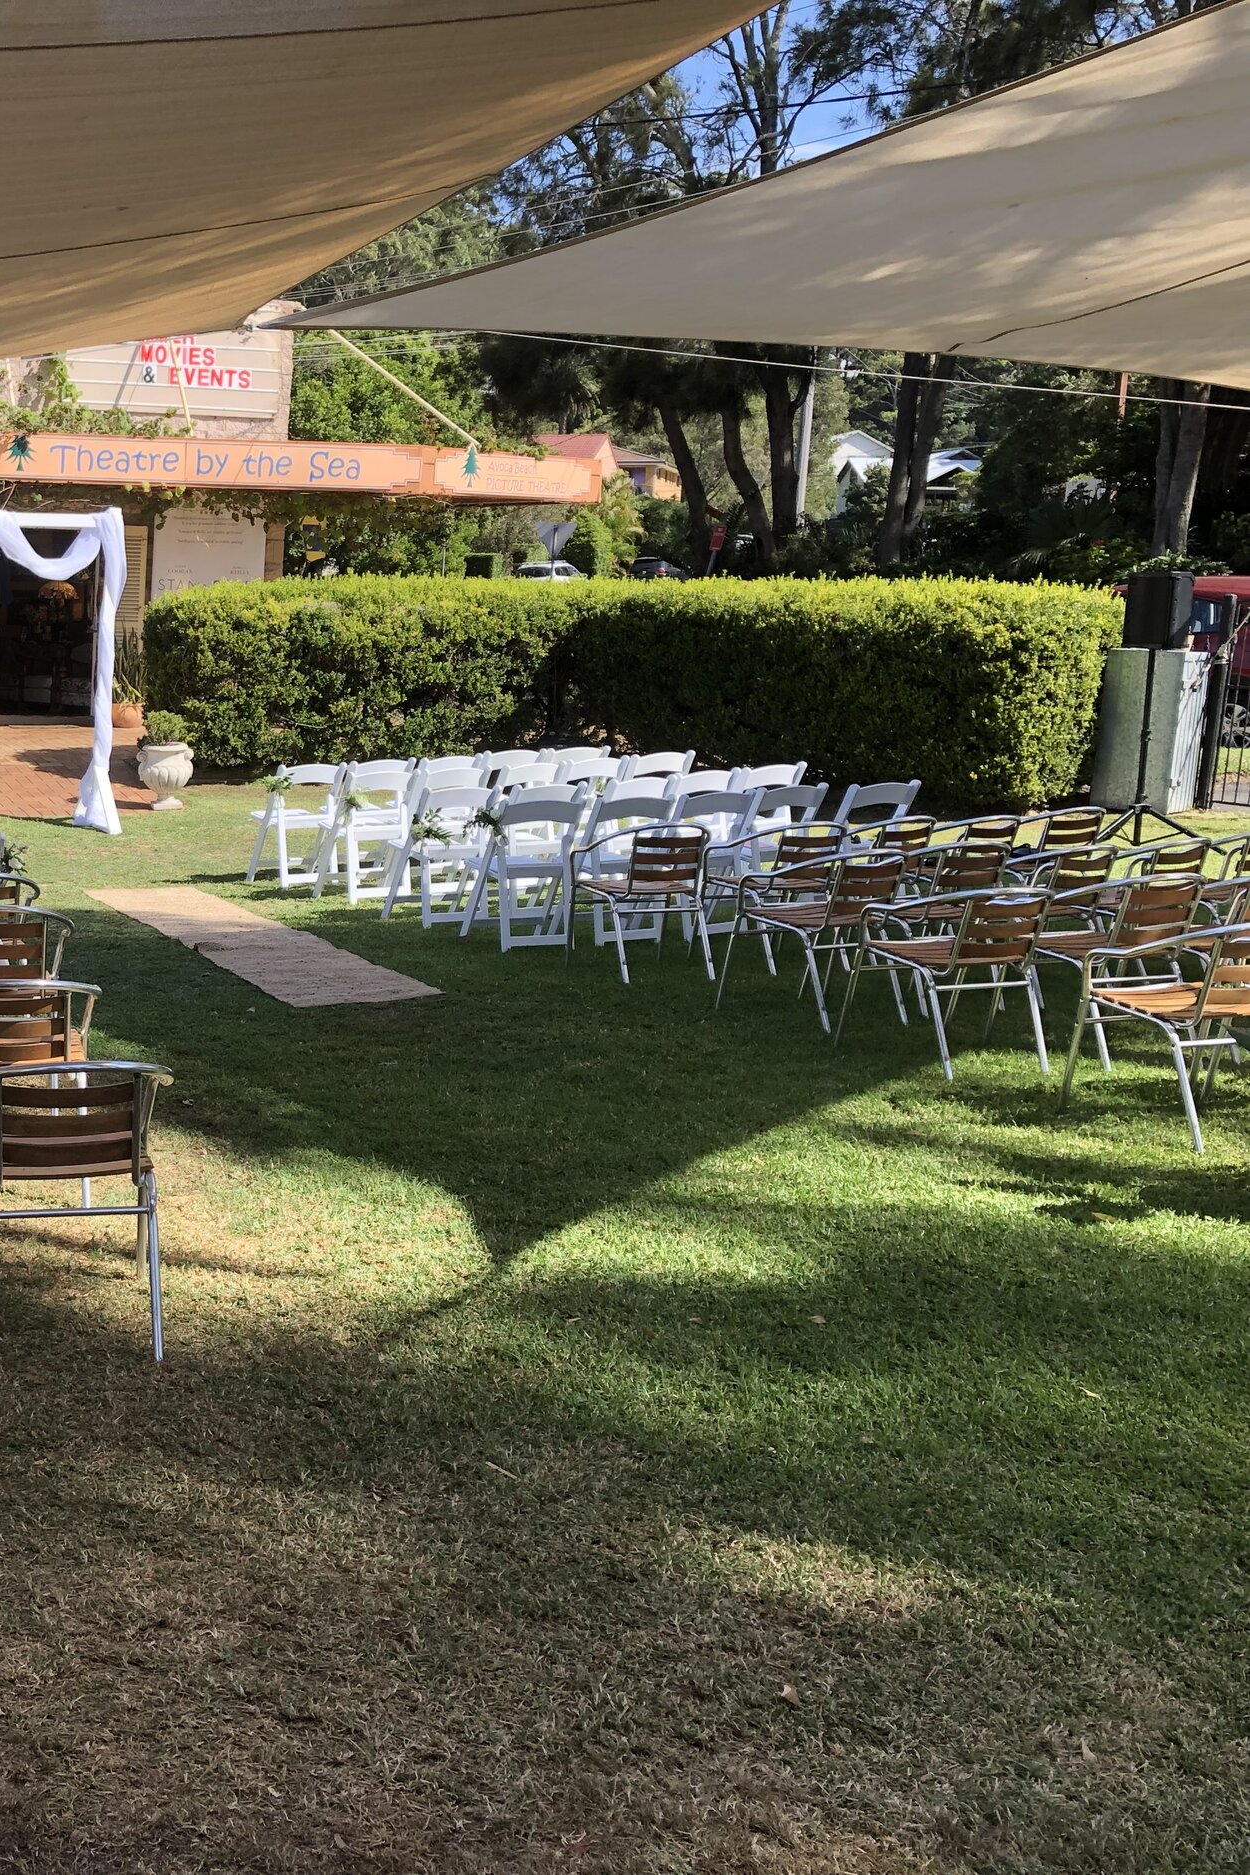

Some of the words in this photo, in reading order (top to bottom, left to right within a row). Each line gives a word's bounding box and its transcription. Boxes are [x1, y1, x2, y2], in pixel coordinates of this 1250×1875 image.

[140, 345, 215, 366] MOVIES
[143, 366, 155, 384] &
[169, 366, 251, 389] EVENTS
[50, 444, 179, 474] Theatre
[196, 448, 229, 478] by
[242, 450, 293, 478] the
[308, 450, 361, 482] Sea
[487, 461, 513, 473] Avoca
[514, 462, 538, 475] Beach
[486, 477, 524, 492] PICTURE
[528, 481, 567, 495] THEATRE
